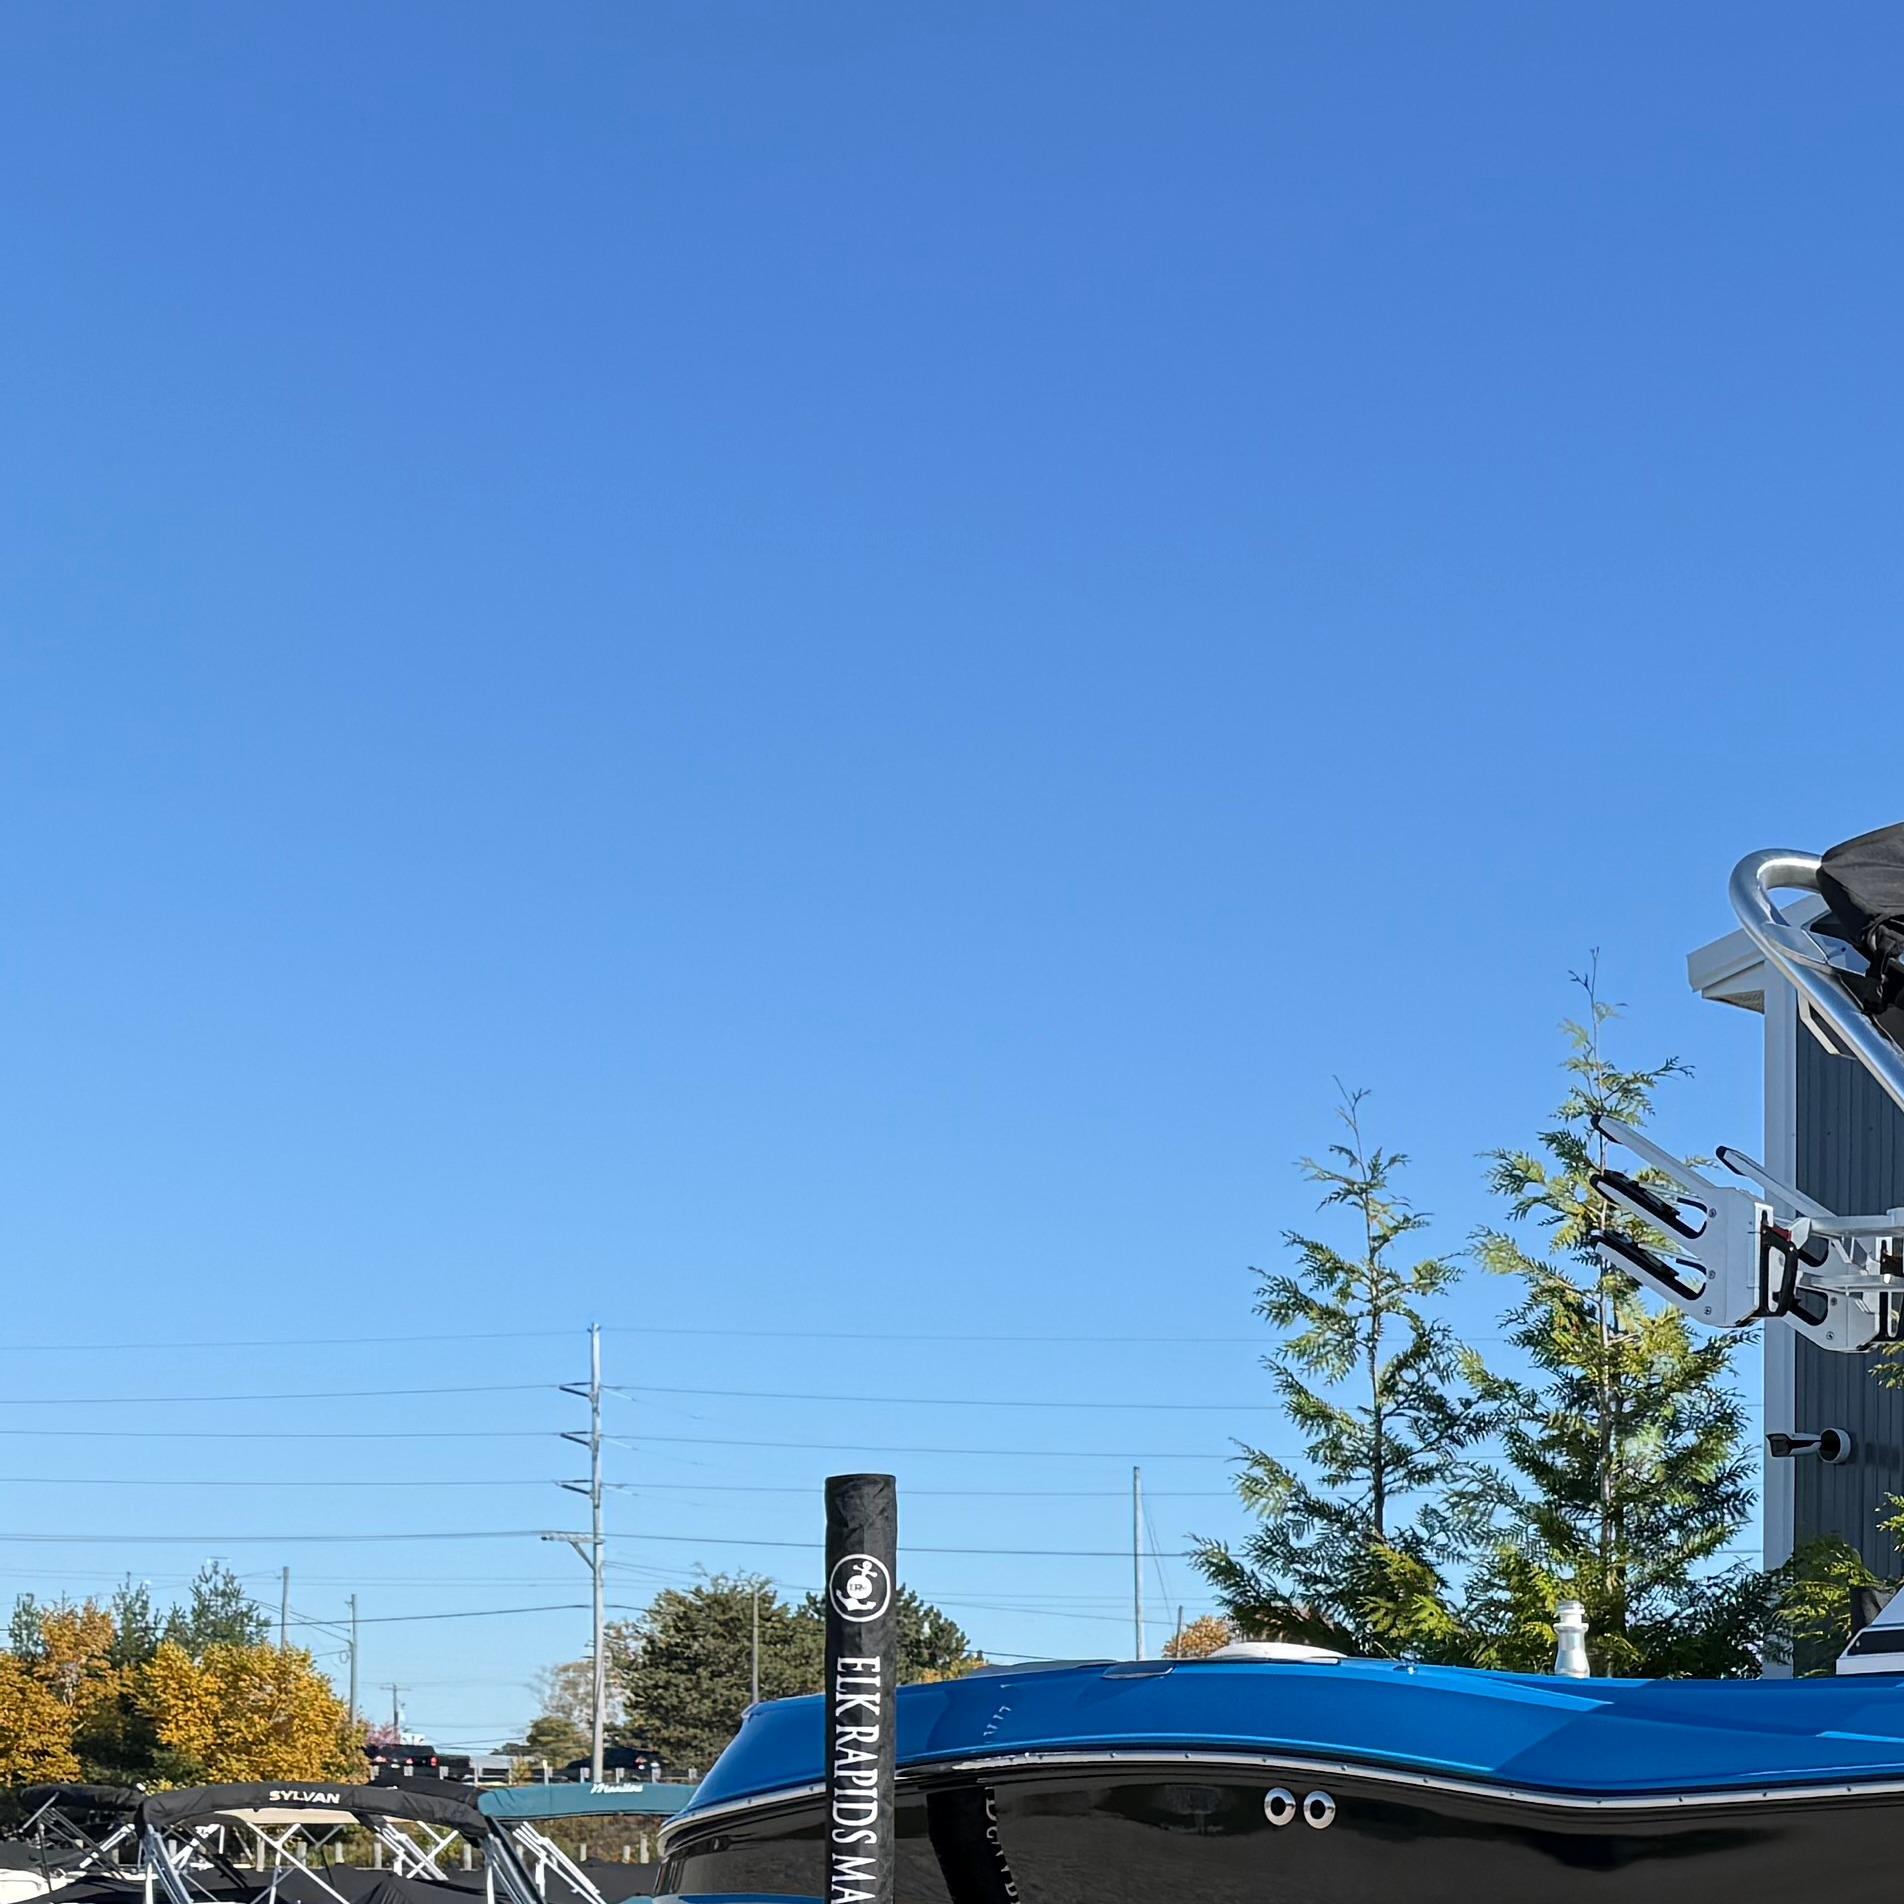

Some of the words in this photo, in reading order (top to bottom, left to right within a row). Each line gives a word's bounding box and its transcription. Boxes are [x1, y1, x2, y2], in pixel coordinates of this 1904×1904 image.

[835, 1655, 881, 1717] ELK
[269, 1790, 340, 1804] SYLVAN
[831, 1724, 880, 1845] RAPIDS
